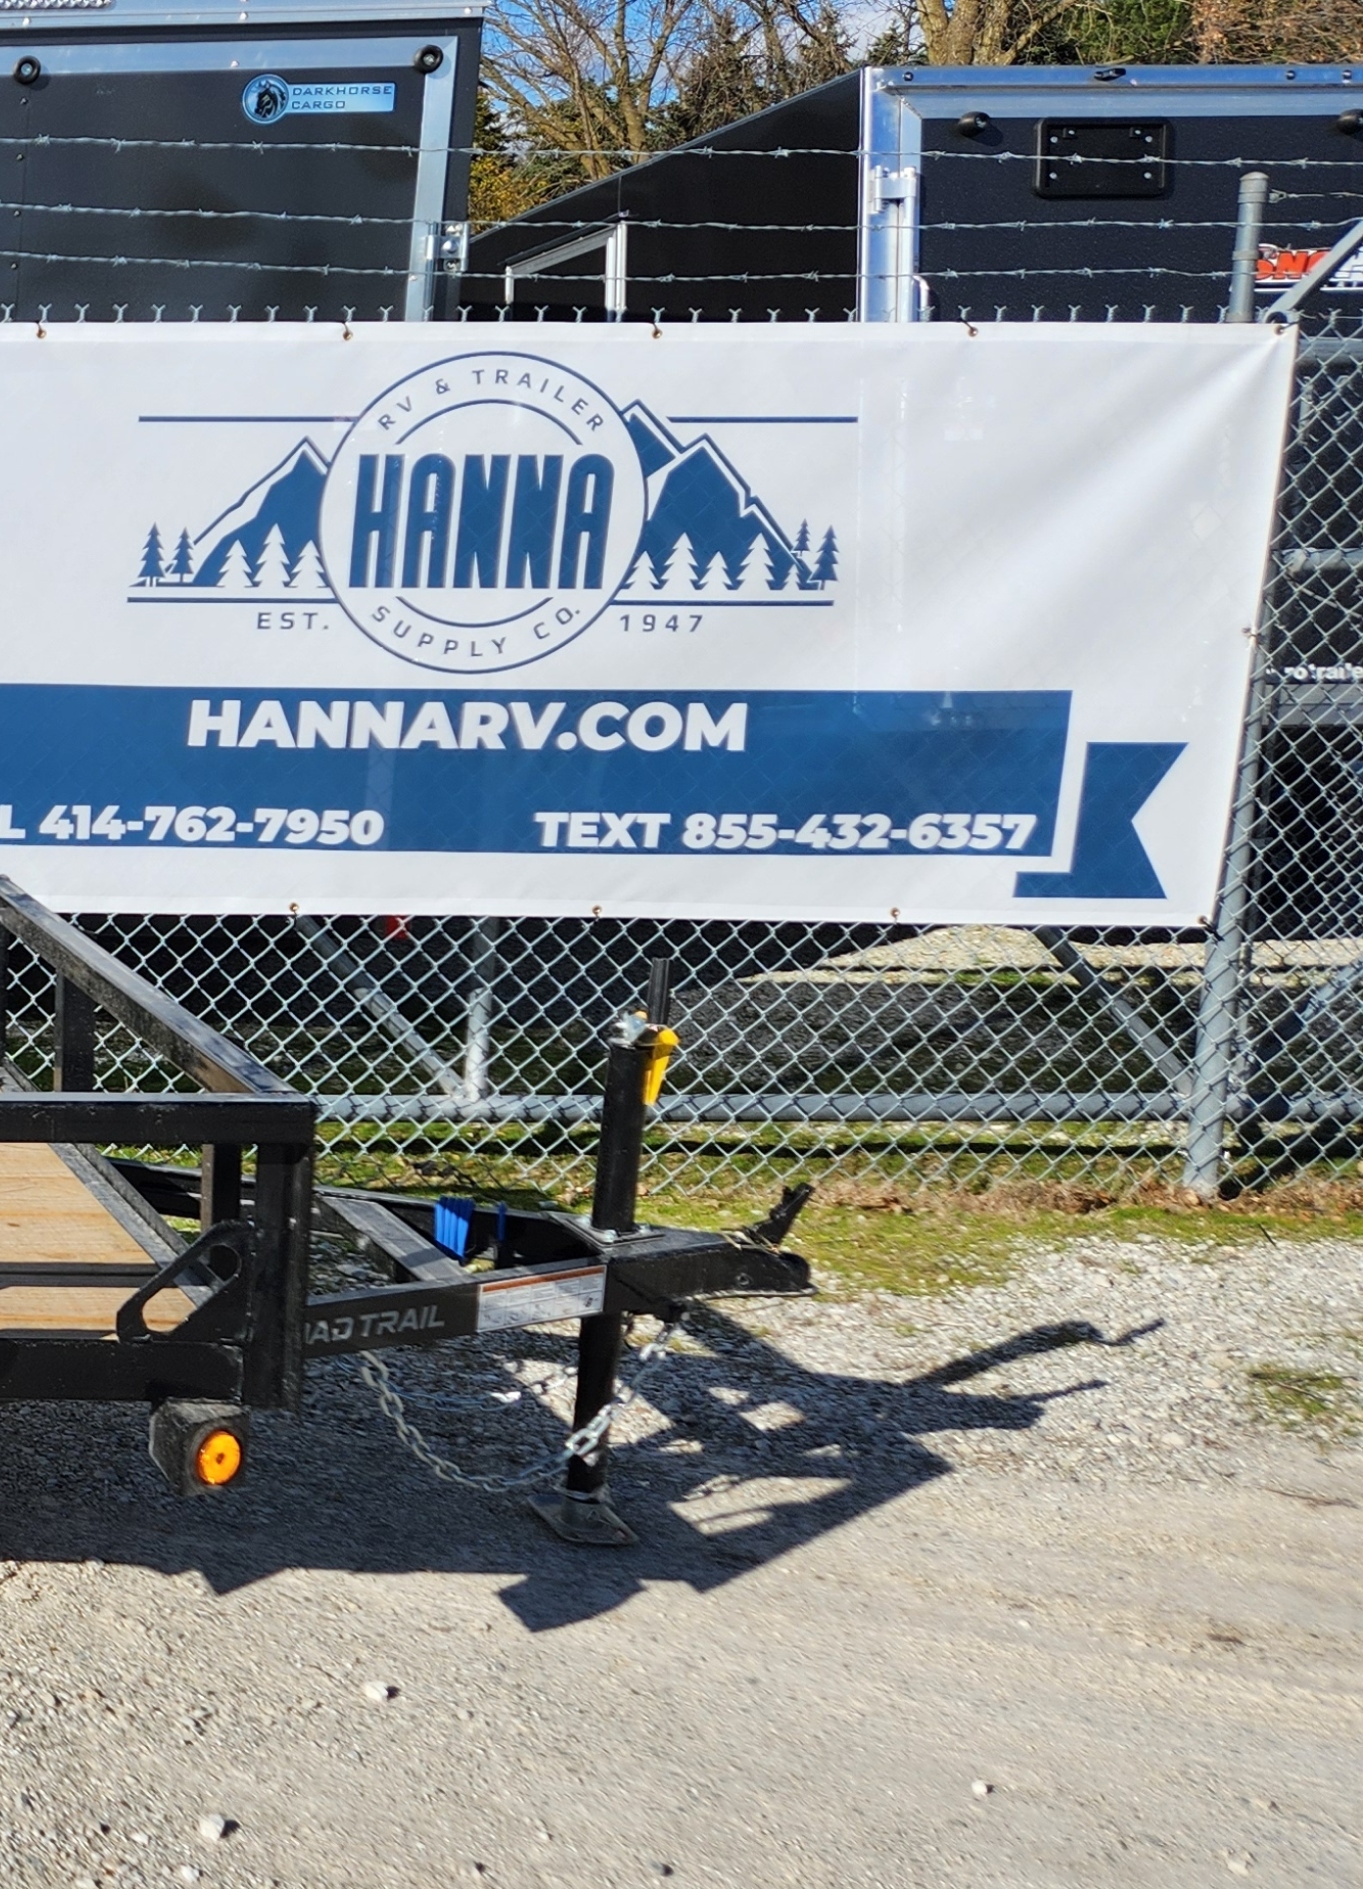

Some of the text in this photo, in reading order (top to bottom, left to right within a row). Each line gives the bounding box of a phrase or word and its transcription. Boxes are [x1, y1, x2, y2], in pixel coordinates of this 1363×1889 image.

[291, 100, 346, 110] CARGO
[292, 85, 392, 96] DARKHORSE
[377, 369, 604, 431] RV & TRAILER
[348, 453, 615, 590] HANNA
[255, 612, 704, 632] EST. 1947
[371, 605, 581, 658] SUPPLY CO.
[187, 699, 749, 752] HANNARV.COM
[38, 804, 385, 846] 414-762-7950
[534, 811, 1037, 850] TEXT 855-432-6357
[360, 1304, 445, 1339] TRAIL
